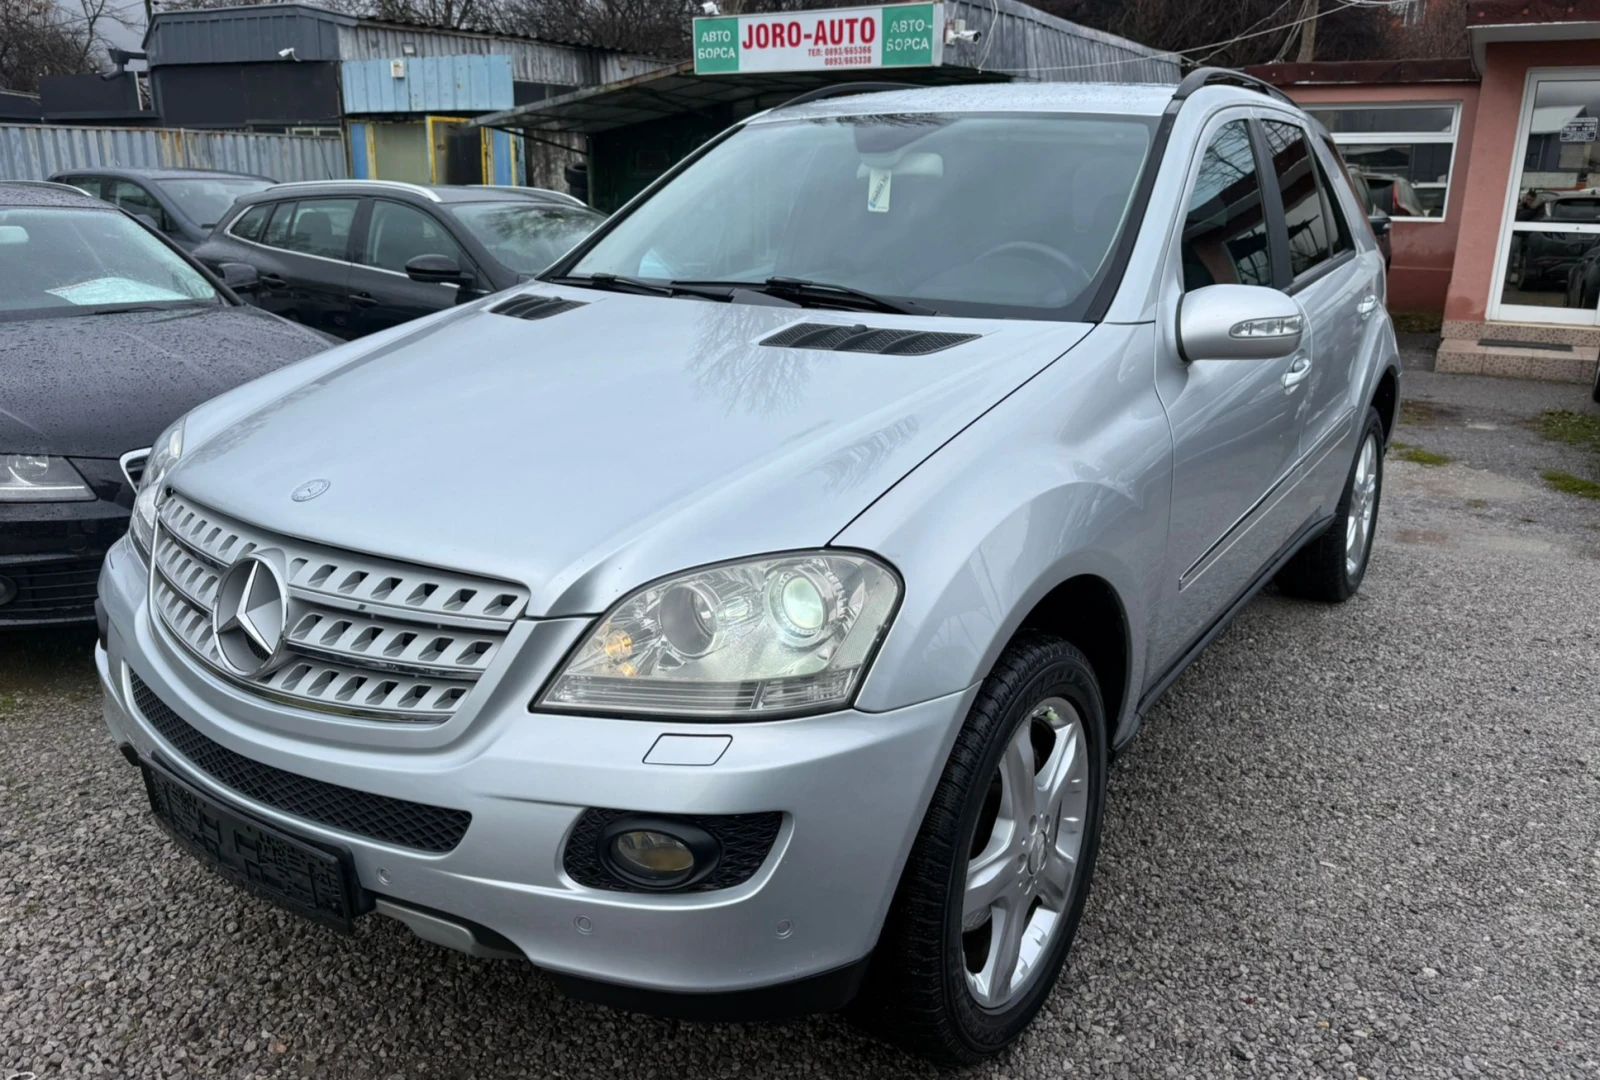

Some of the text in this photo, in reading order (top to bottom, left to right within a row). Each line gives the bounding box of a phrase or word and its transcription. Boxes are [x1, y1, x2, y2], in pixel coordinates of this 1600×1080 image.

[701, 30, 731, 43] АВТО
[742, 16, 876, 50] JORO-AUTO
[886, 37, 930, 52] БОРСА
[698, 47, 736, 60] БОРСА
